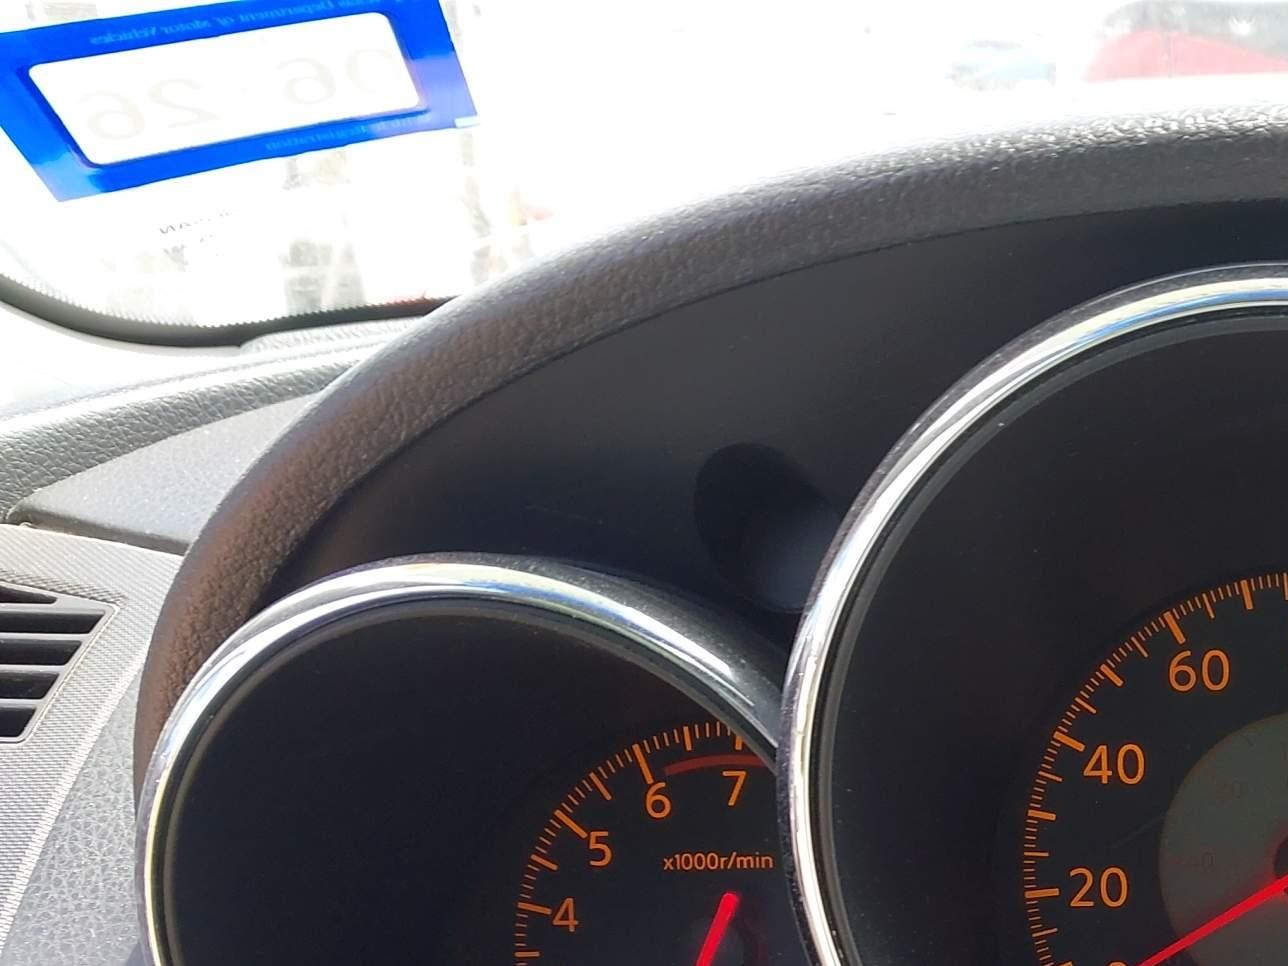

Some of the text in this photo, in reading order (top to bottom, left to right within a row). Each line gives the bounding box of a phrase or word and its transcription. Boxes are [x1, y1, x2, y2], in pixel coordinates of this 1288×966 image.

[1169, 649, 1230, 692] 60
[1081, 743, 1145, 785] 40
[646, 779, 671, 819] 6
[722, 770, 747, 806] 7
[589, 831, 612, 866] 5
[664, 852, 773, 870] x1000r/min
[1070, 867, 1128, 908] 20
[553, 897, 577, 930] 4
